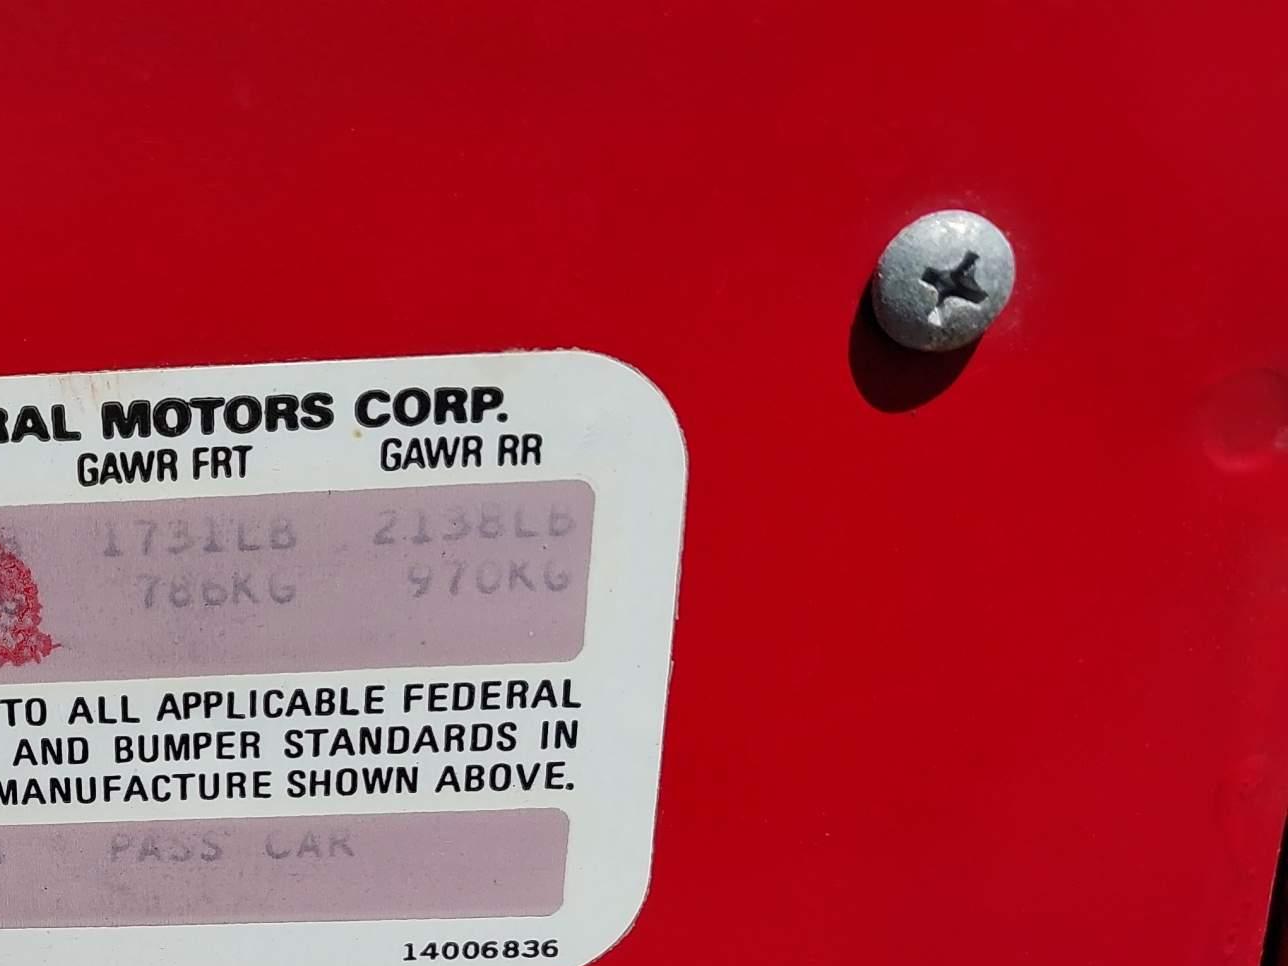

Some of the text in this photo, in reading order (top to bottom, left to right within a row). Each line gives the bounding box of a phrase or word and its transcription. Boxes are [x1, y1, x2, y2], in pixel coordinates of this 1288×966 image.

[102, 392, 335, 441] MOTORS
[354, 386, 510, 429] CORP.
[78, 449, 179, 488] GAWR
[193, 444, 254, 480] FRT
[380, 436, 482, 473] GAWR
[497, 433, 543, 467] RR
[102, 518, 299, 559] 1731LB
[373, 505, 577, 546] 2138LB
[141, 571, 298, 610] 786KG
[409, 558, 572, 600] 970KG
[0, 697, 48, 728] TO
[67, 694, 141, 726] ALL
[156, 684, 386, 722] APPLICABLE
[402, 678, 583, 714] FEDERAL
[12, 736, 90, 769] AND
[114, 731, 262, 765] BUMPER
[284, 722, 519, 760] STANDARDS
[540, 719, 580, 751] IN
[286, 765, 420, 799] SHOWN
[435, 760, 575, 795] ABOVE.
[110, 829, 225, 864] PASS
[264, 828, 356, 860] CAR
[402, 939, 559, 962] 14006836
